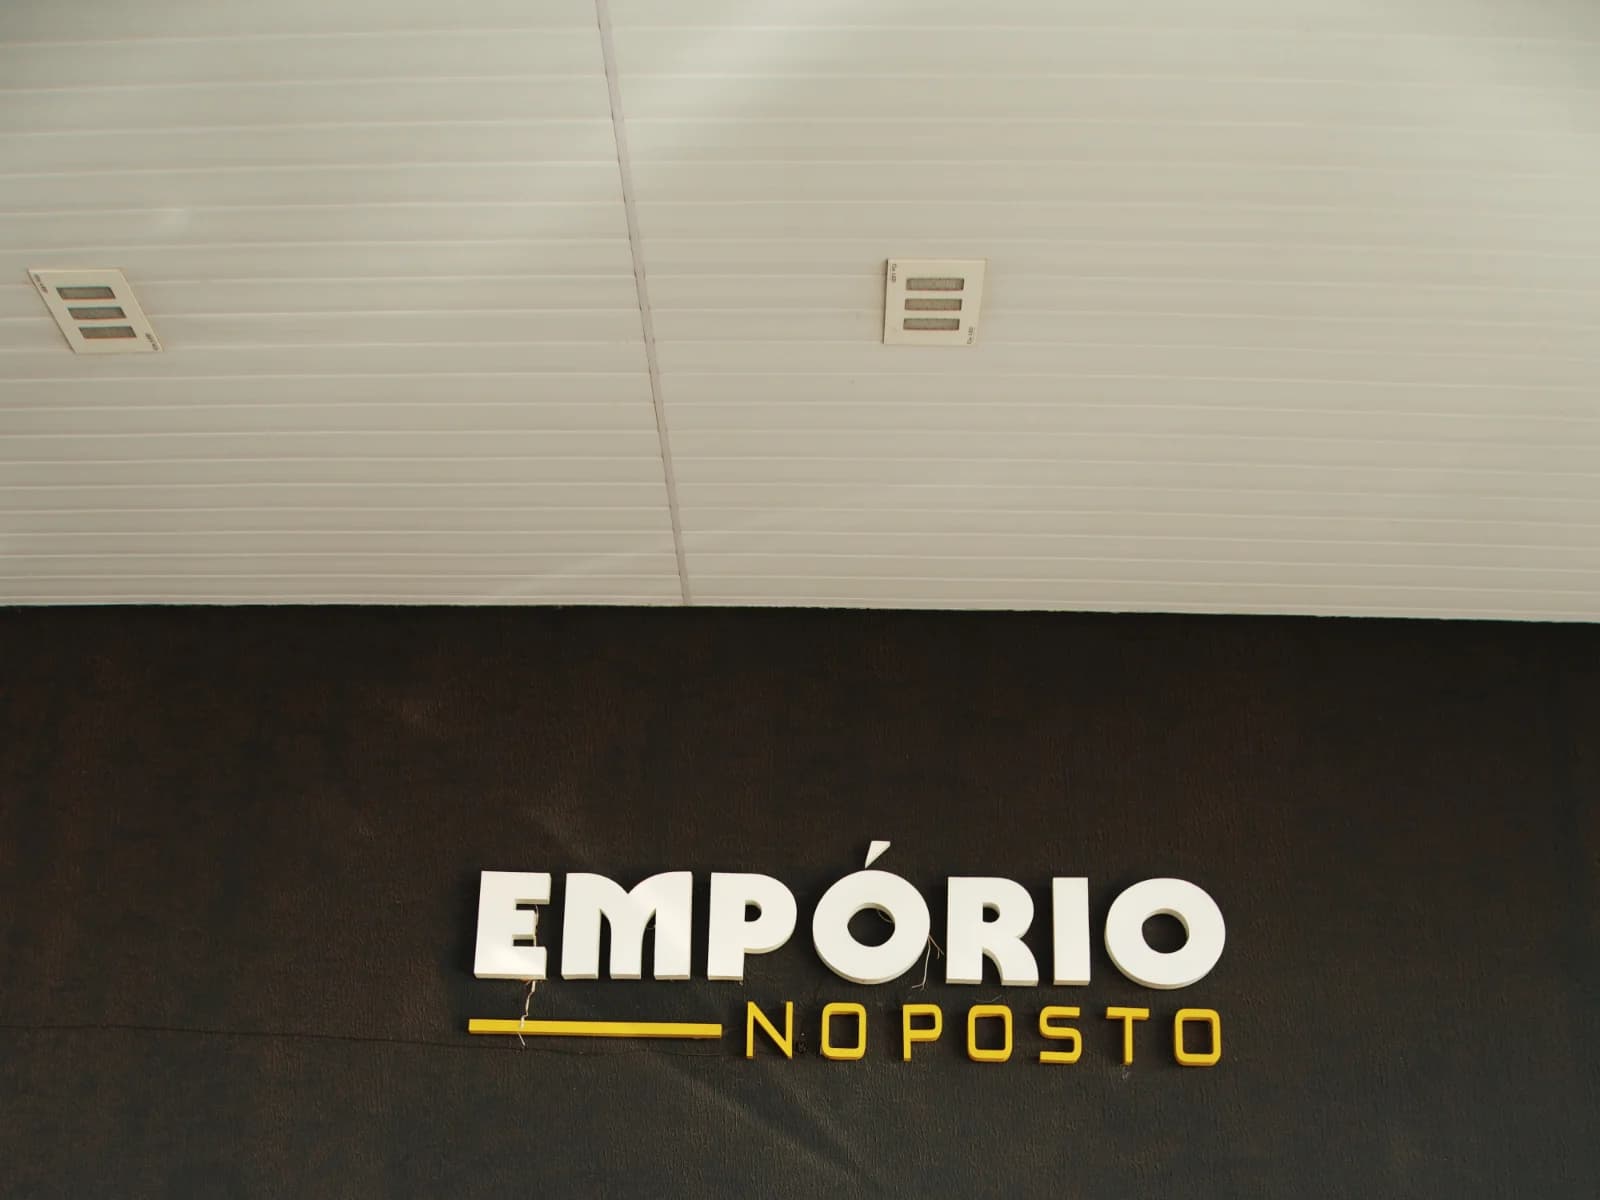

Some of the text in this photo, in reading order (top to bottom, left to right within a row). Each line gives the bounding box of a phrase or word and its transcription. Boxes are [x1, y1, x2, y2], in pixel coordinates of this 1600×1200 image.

[474, 840, 1226, 990] EMPÓRIO
[745, 1000, 1222, 1068] NO POSTO
